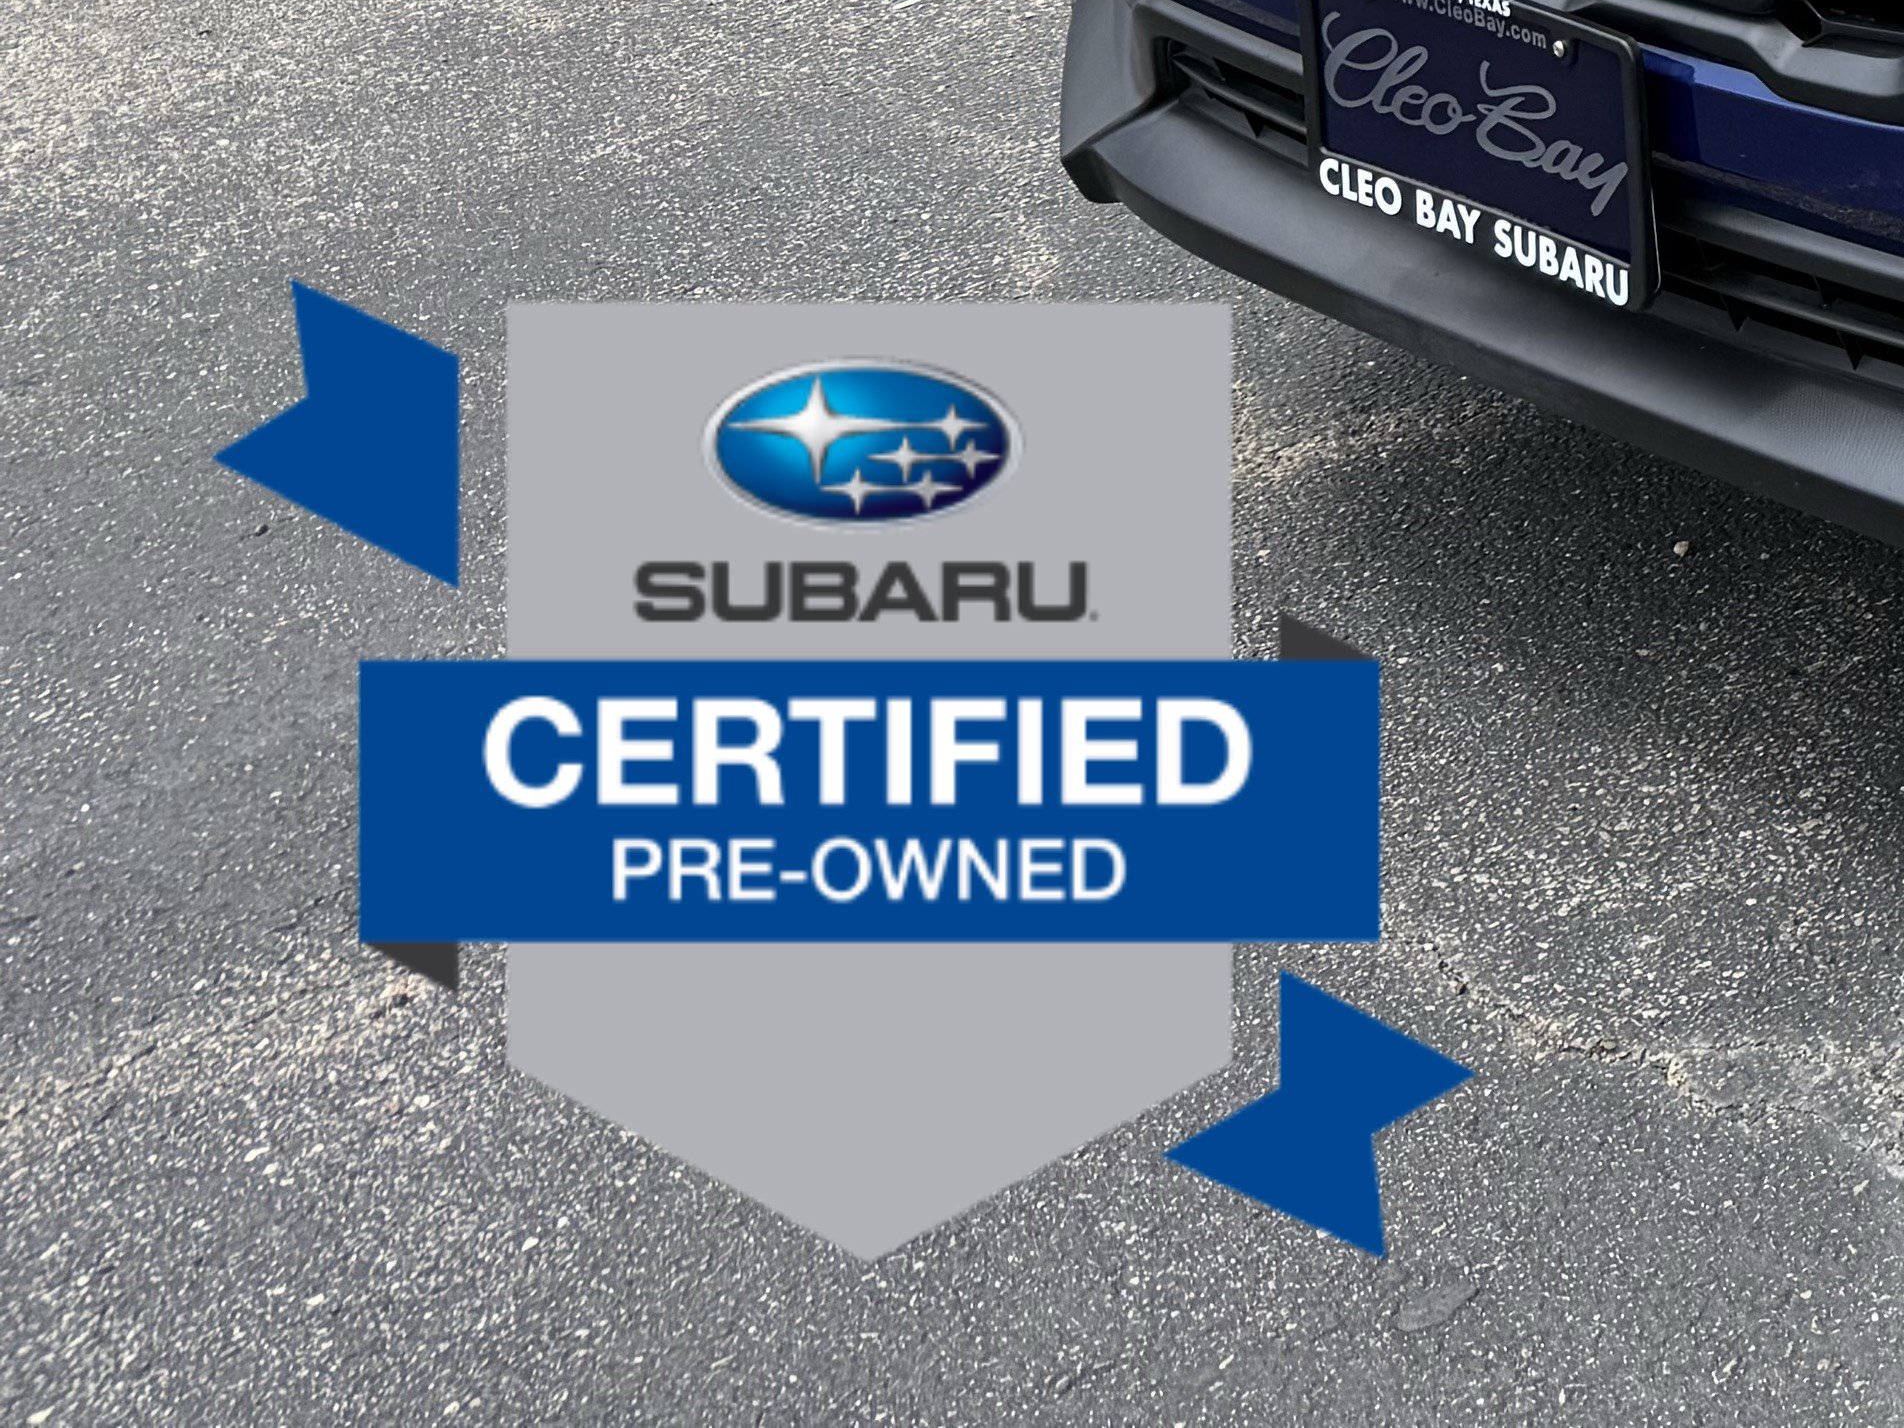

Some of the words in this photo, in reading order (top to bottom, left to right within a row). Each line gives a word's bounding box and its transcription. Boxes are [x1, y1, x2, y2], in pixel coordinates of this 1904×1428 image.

[1321, 11, 1477, 135] Cleo
[1475, 60, 1628, 217] Bay
[1319, 158, 1402, 216] CLEO
[1415, 189, 1482, 244] BAY
[1493, 218, 1629, 307] SUBARU
